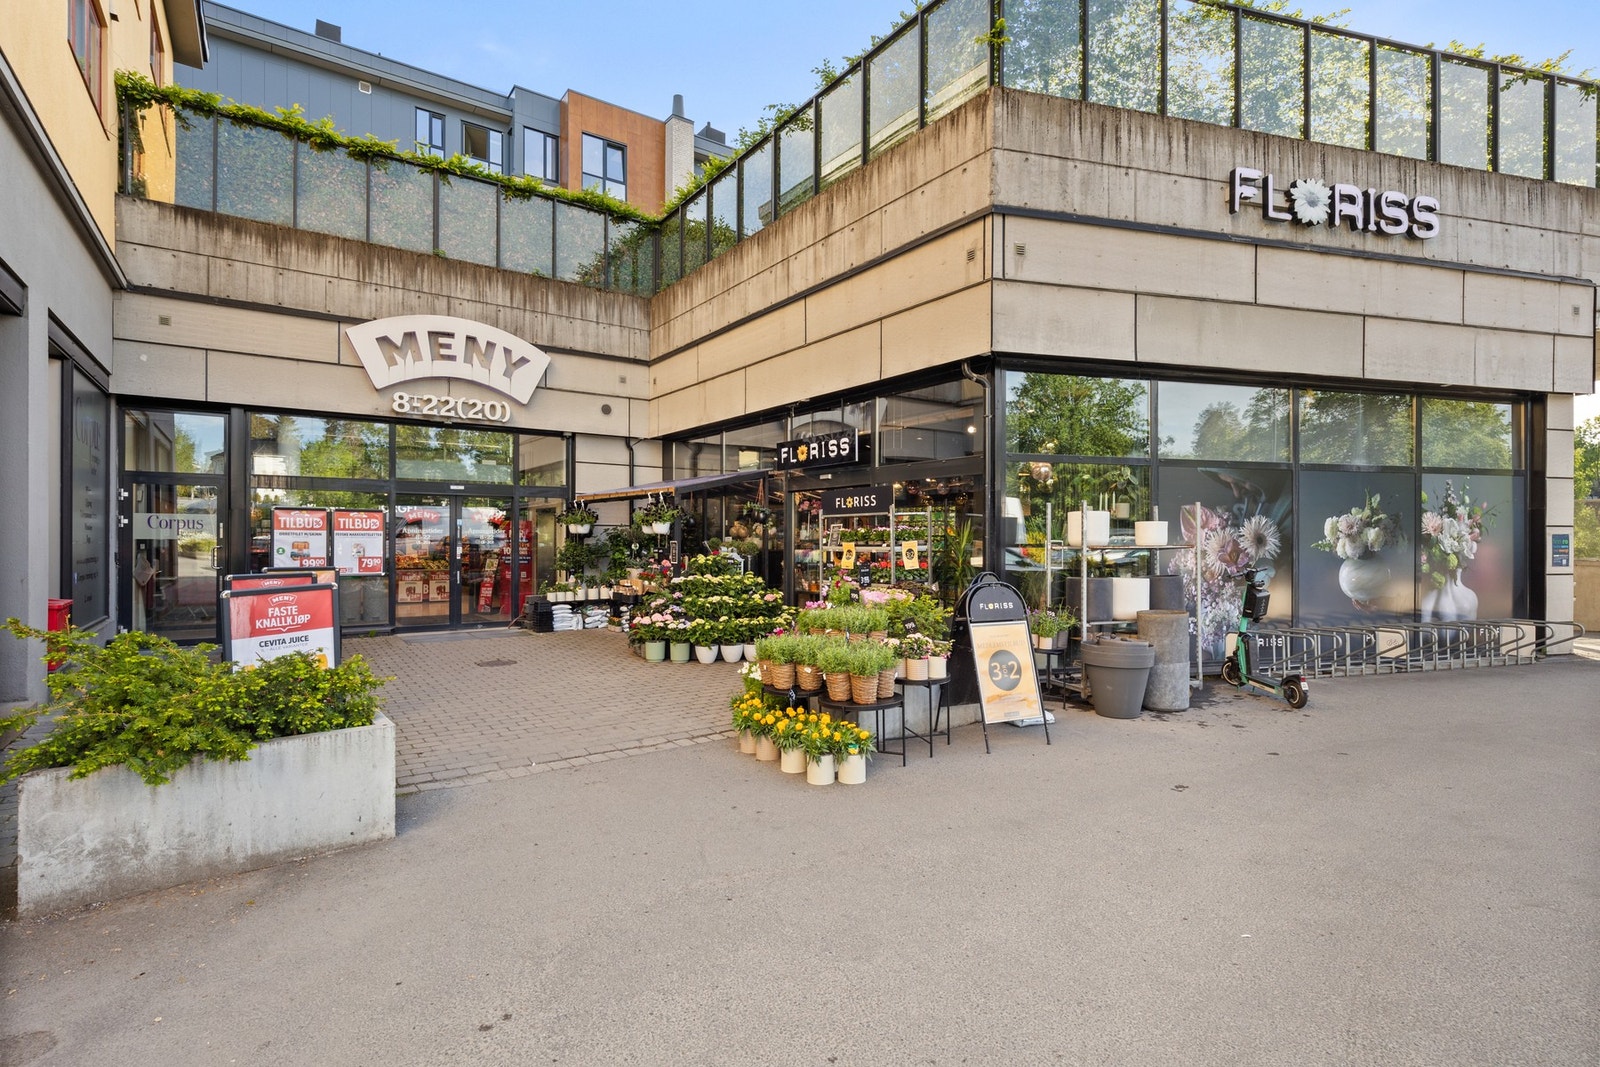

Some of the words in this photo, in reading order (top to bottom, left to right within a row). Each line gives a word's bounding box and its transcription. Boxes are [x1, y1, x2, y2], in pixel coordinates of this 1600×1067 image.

[1229, 166, 1441, 239] FLORISS
[375, 330, 531, 379] MENY
[781, 437, 850, 464] FLORISS
[835, 494, 877, 509] FLORISS
[278, 516, 323, 529] TILBUD
[408, 511, 437, 520] MENY
[147, 514, 204, 537] Corpus
[338, 517, 380, 529] TILBUD
[272, 595, 295, 603] MENY
[979, 602, 1014, 610] FLORISS
[268, 605, 298, 618] FASTE
[255, 614, 311, 629] KNALLKJØP
[259, 638, 287, 648] CEVITA
[288, 635, 309, 644] JUICE
[990, 662, 1002, 681] 3
[1008, 660, 1020, 679] 2
